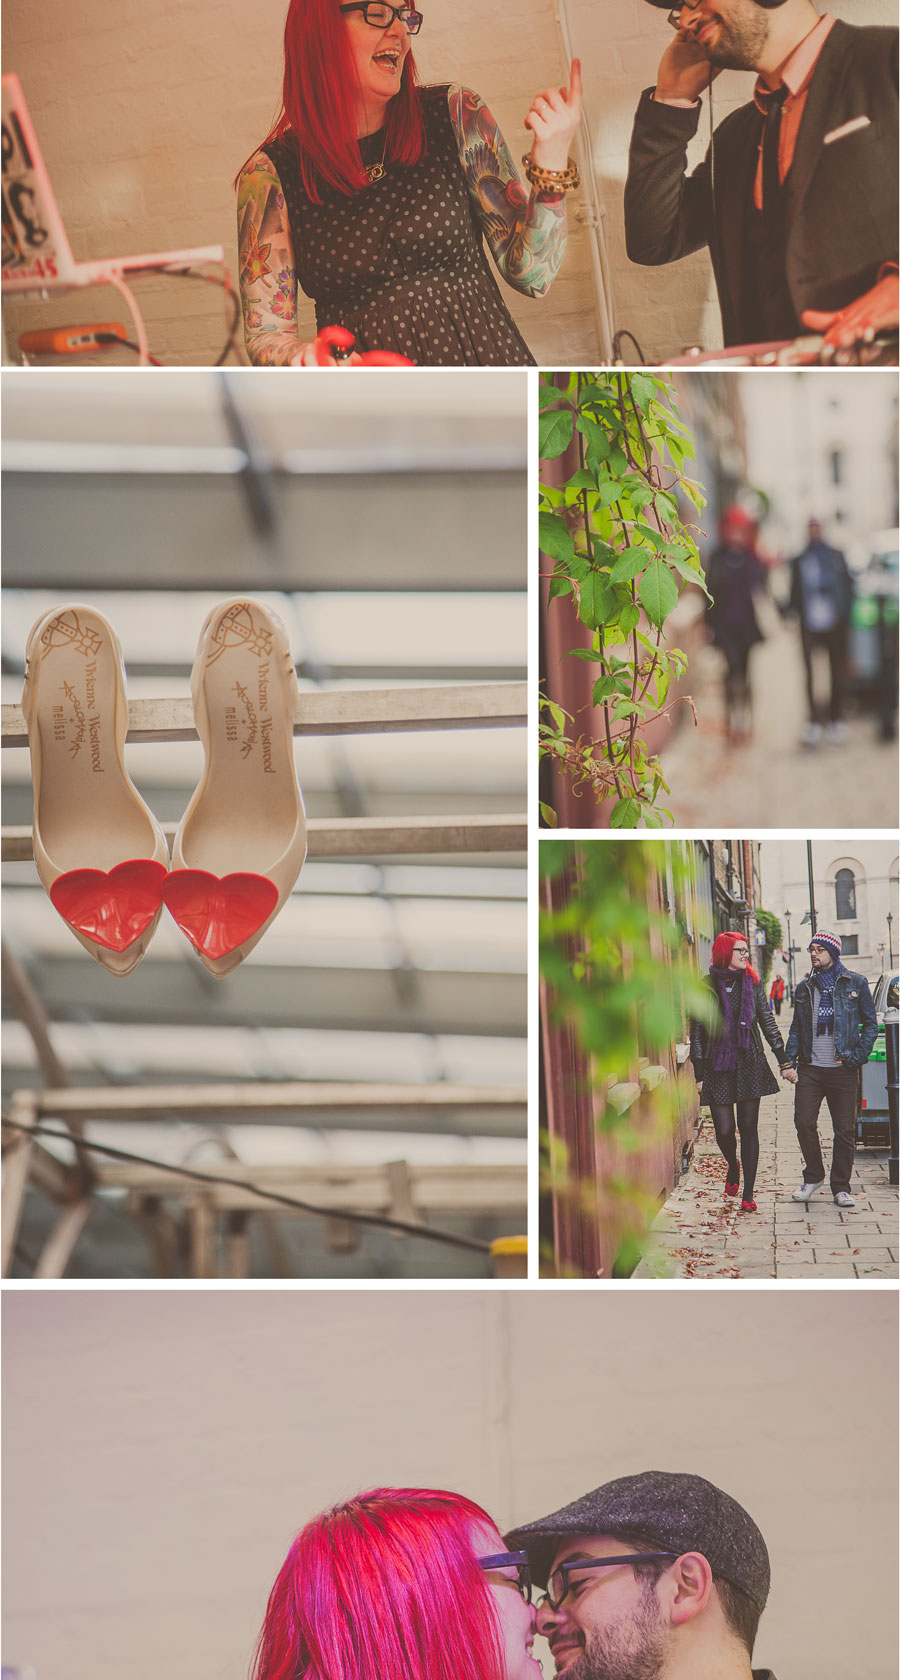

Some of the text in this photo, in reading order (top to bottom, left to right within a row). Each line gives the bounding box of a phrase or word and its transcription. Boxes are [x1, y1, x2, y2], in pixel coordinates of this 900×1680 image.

[52, 705, 66, 741] melissa
[84, 660, 105, 772] Vivienne Westwood
[225, 707, 240, 741] melissa
[258, 661, 276, 773] Vivienne Westwood
